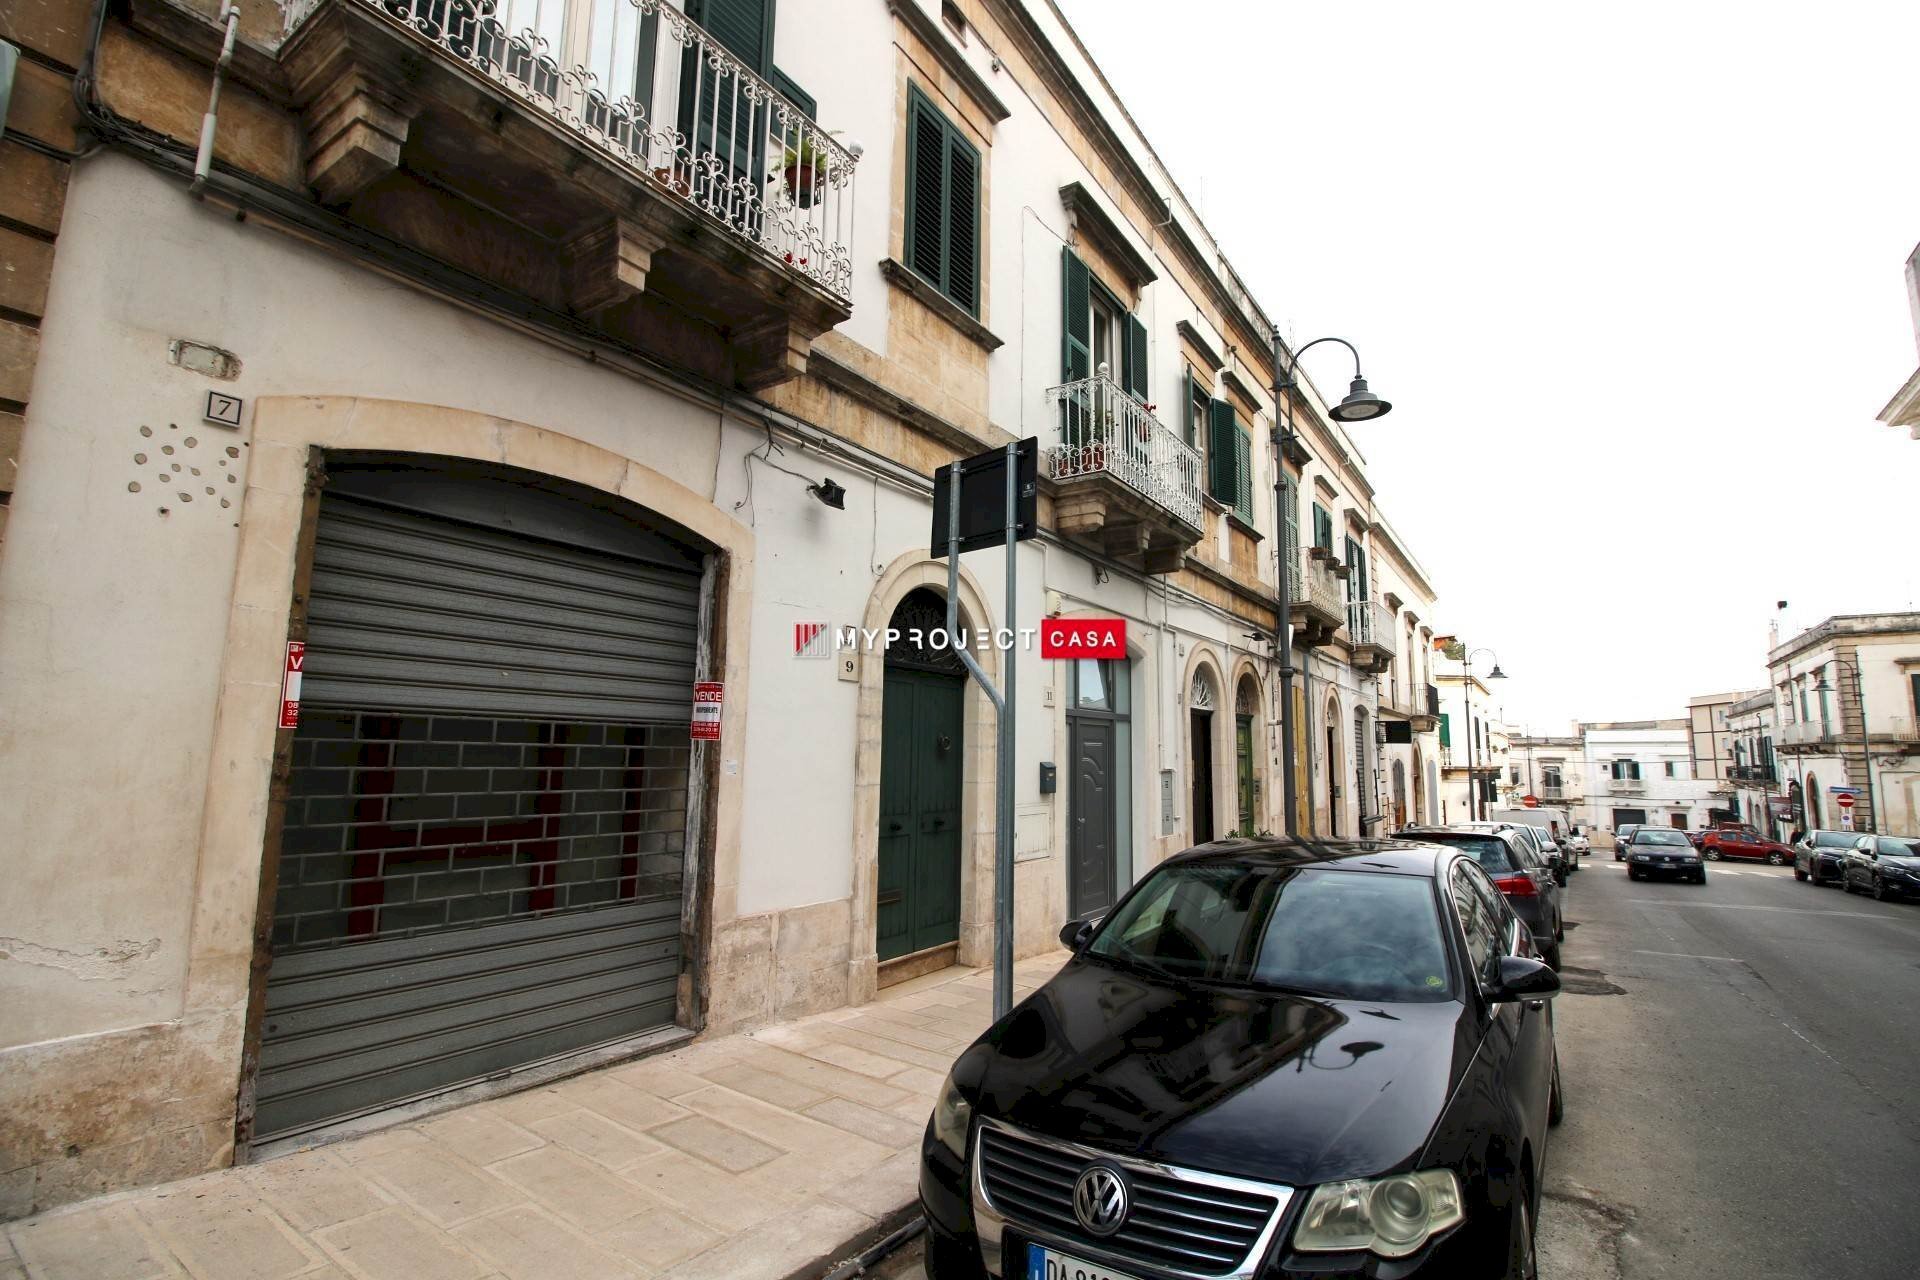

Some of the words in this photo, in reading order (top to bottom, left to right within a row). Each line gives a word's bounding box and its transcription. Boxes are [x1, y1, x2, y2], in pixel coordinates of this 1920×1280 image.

[219, 399, 232, 416] 7
[846, 661, 854, 673] 9
[695, 691, 722, 702] VENDE
